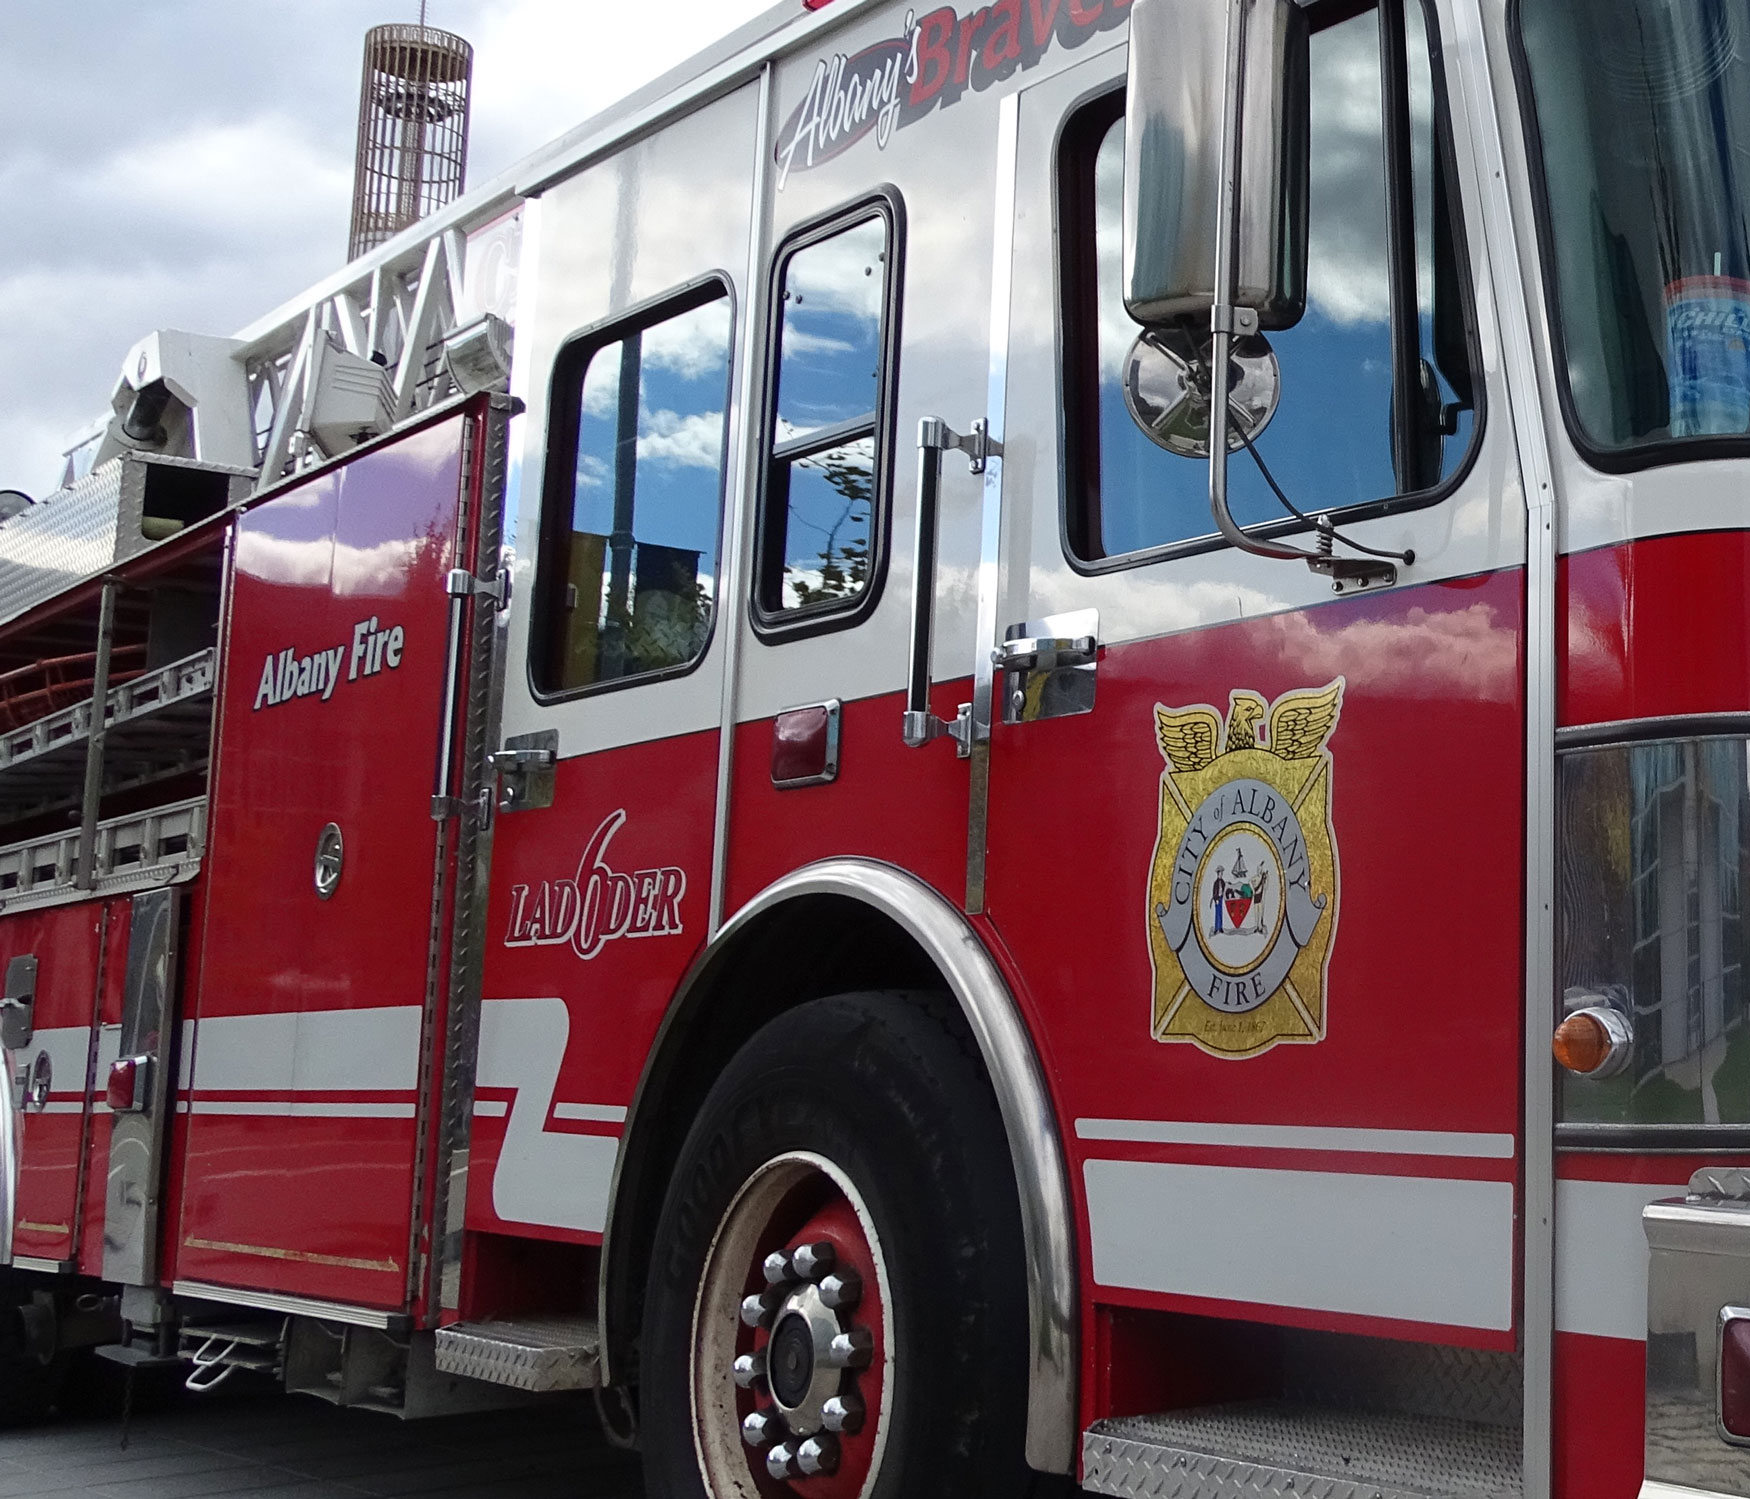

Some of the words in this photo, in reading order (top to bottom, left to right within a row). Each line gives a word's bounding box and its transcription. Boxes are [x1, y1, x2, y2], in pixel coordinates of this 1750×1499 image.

[778, 9, 922, 191] Albany's
[253, 646, 346, 710] Albany
[348, 615, 404, 681] Fire
[1174, 816, 1208, 905] CITY
[1213, 794, 1226, 822] of
[1231, 788, 1307, 892] ALBANY
[1207, 972, 1266, 1006] FIRE
